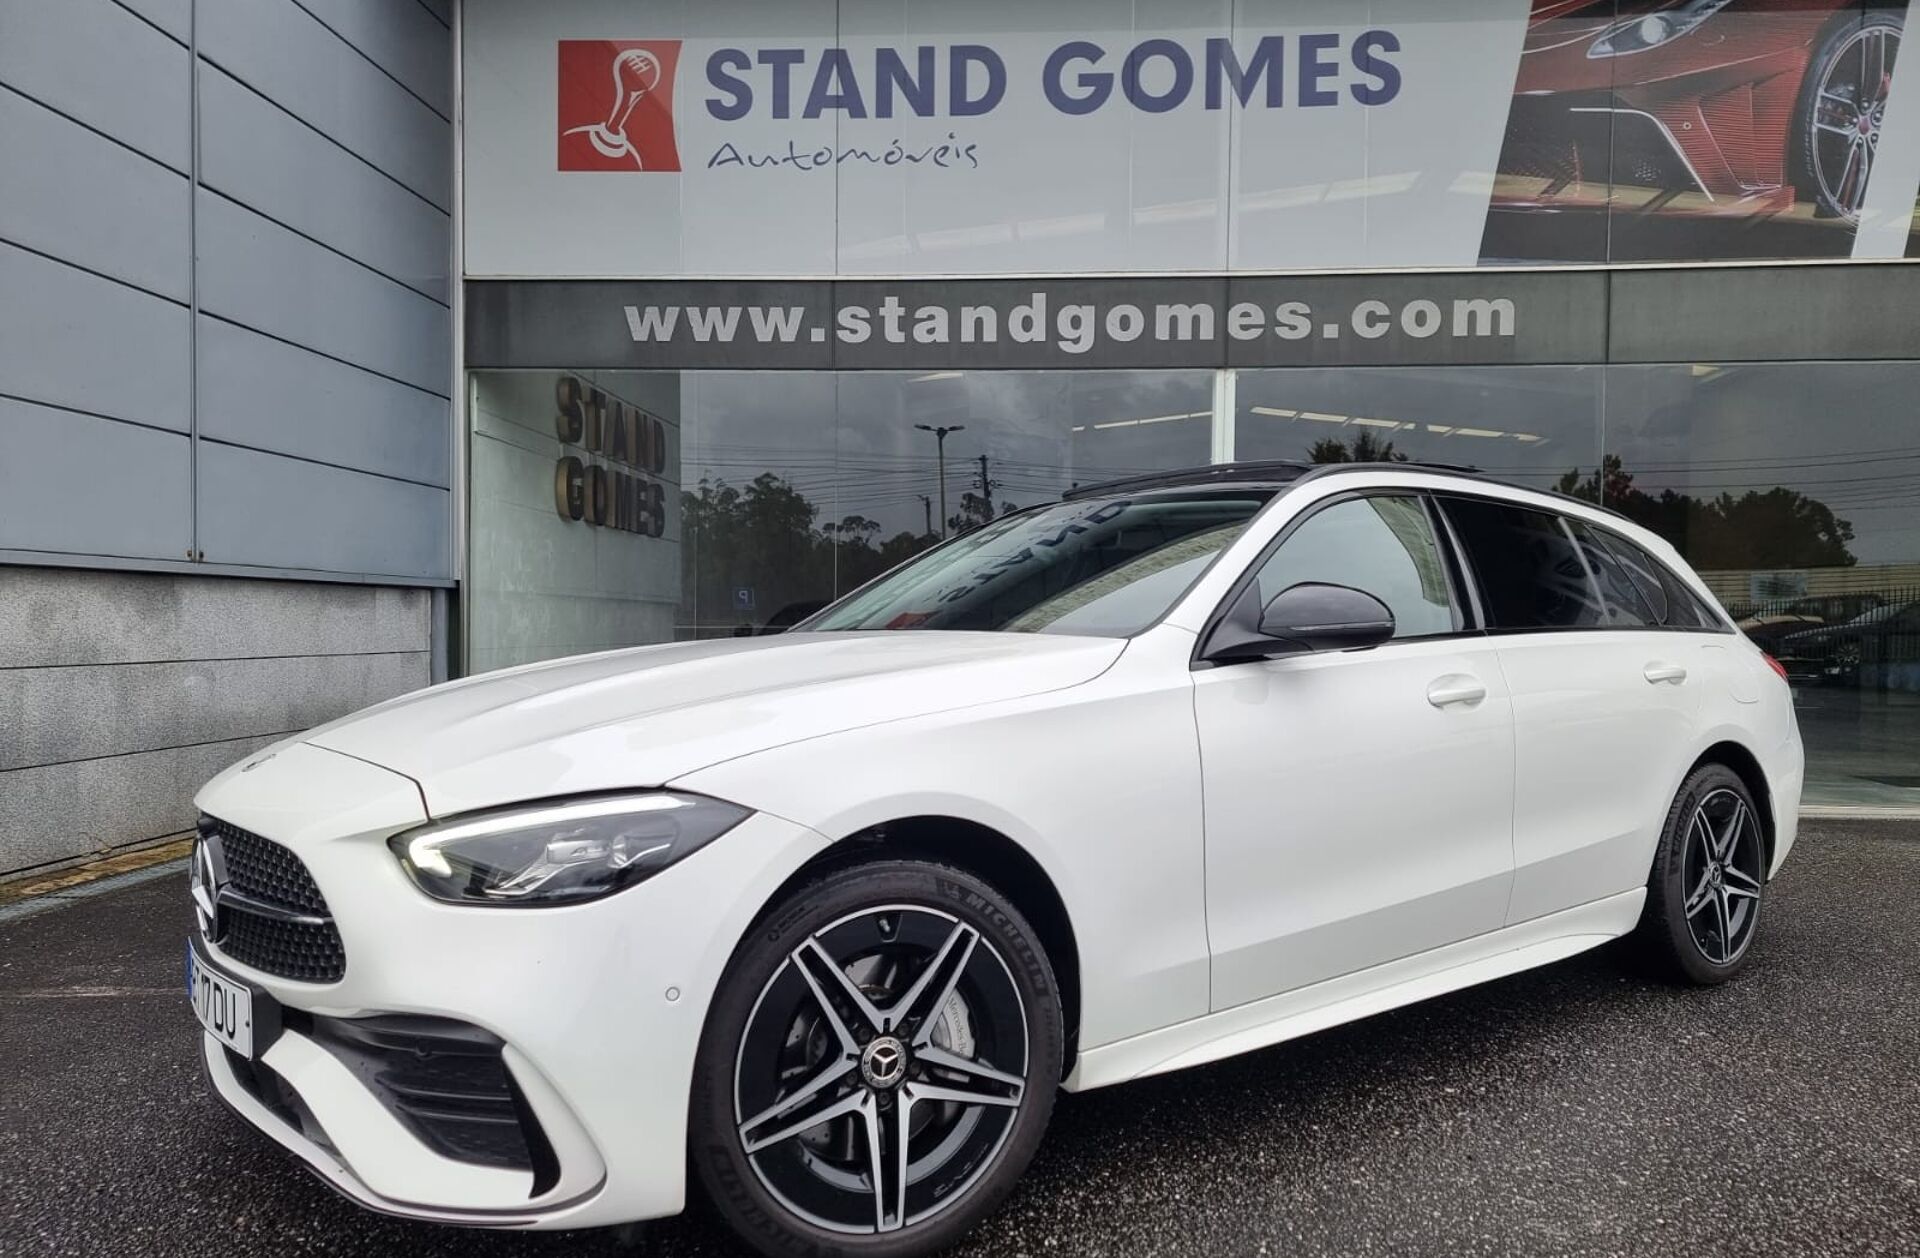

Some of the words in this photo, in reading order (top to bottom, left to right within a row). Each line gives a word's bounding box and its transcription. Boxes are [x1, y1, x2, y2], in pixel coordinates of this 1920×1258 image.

[705, 45, 1007, 120] STAND
[1042, 30, 1402, 115] GOMES
[708, 134, 978, 170] Automóveis
[624, 293, 1516, 354] www.standgomes.com
[556, 377, 665, 474] STAND
[555, 456, 665, 538] GOMES
[965, 891, 1047, 990] MICHELIN
